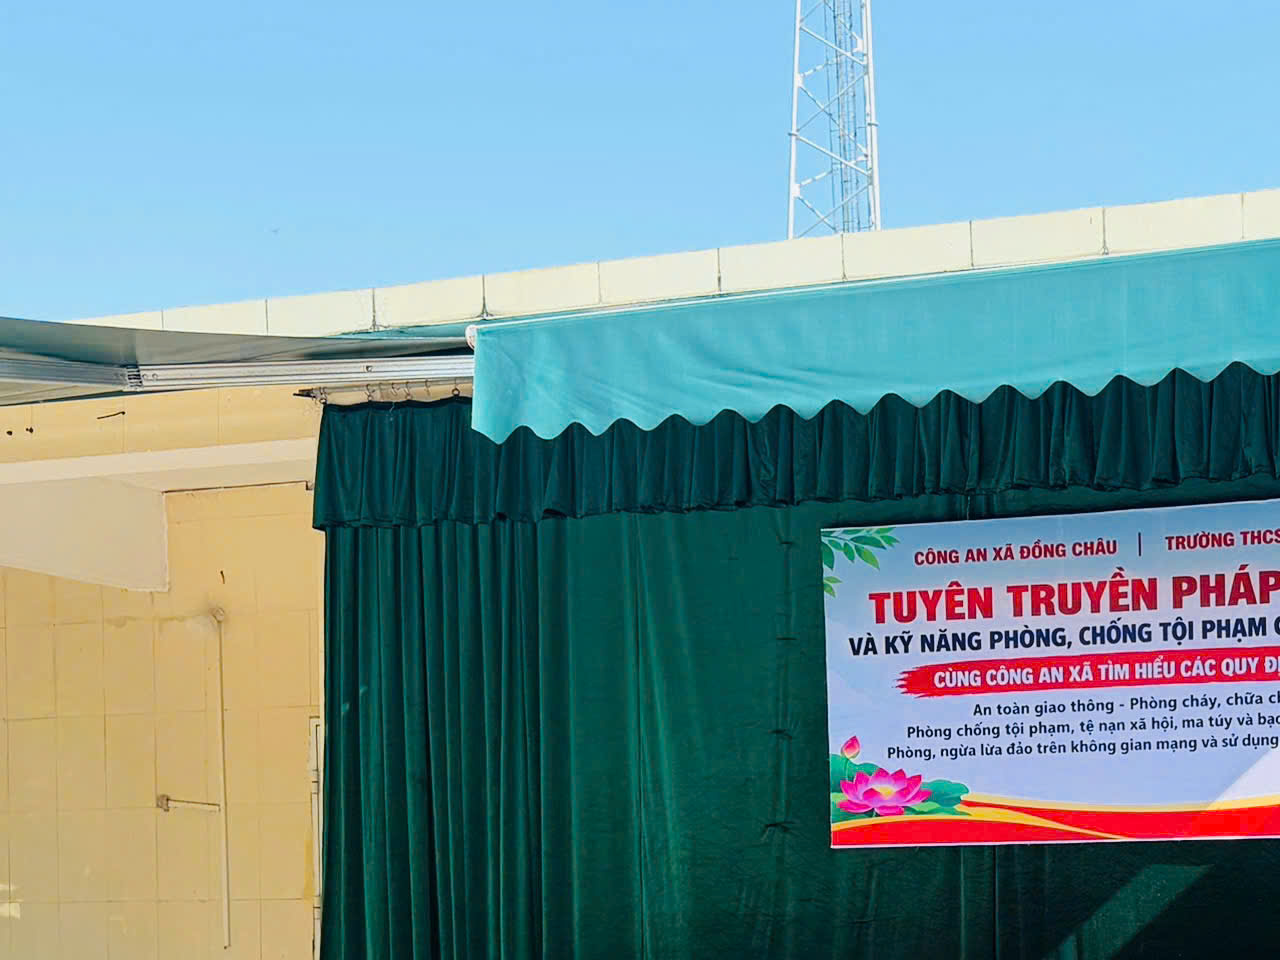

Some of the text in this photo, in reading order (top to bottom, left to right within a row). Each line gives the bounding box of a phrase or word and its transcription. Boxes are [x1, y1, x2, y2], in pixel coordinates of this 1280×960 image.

[914, 538, 1118, 565] CÔNG AN XÃ ĐỒNG CHÂU
[1165, 529, 1235, 551] TRƯỜNG
[868, 580, 993, 625] TUYÊN
[1007, 566, 1157, 618] TRUYỀN
[848, 631, 878, 656] VÀ
[884, 631, 914, 654] KỸ
[920, 628, 982, 653] NĂNG
[989, 624, 1073, 650] PHÒNG,
[1078, 616, 1152, 645] CHỐNG
[1159, 616, 1194, 645] TỘI
[1201, 615, 1267, 643] PHẠM
[934, 666, 982, 688] CÙNG
[986, 662, 1034, 686] CÔNG
[1039, 665, 1065, 683] AN
[1068, 662, 1092, 682] XÃ
[1097, 659, 1129, 681] TÌM
[1135, 654, 1176, 679] HIỂU
[1180, 654, 1217, 676] CÁC
[1221, 656, 1260, 676] QUY
[973, 704, 992, 716] An
[997, 702, 1030, 715] toàn
[1035, 701, 1066, 717] giao
[1071, 699, 1114, 714] thông
[1130, 696, 1177, 711] Phòng
[1182, 694, 1221, 710] cháy,
[1226, 692, 1263, 705] chữa
[907, 725, 951, 740] Phòng
[957, 722, 1000, 738] chống
[1005, 722, 1024, 738] tội
[1029, 721, 1075, 738] phạm,
[1080, 720, 1094, 735] tệ
[1099, 721, 1125, 734] nạn
[1130, 718, 1147, 730] xã
[1151, 716, 1178, 732] hội,
[1182, 718, 1204, 729] ma
[1209, 714, 1233, 730] túy
[1237, 713, 1253, 726] và
[887, 746, 936, 761] Phòng,
[940, 744, 976, 760] ngừa
[981, 743, 1002, 756] lừa
[1006, 741, 1032, 755] đảo
[1037, 741, 1066, 754] trên
[1071, 739, 1116, 755] không
[1120, 738, 1152, 754] gian
[1156, 738, 1198, 753] mạng
[1202, 736, 1218, 748] và
[1222, 733, 1239, 747] sử
[1242, 733, 1279, 750] dụng
